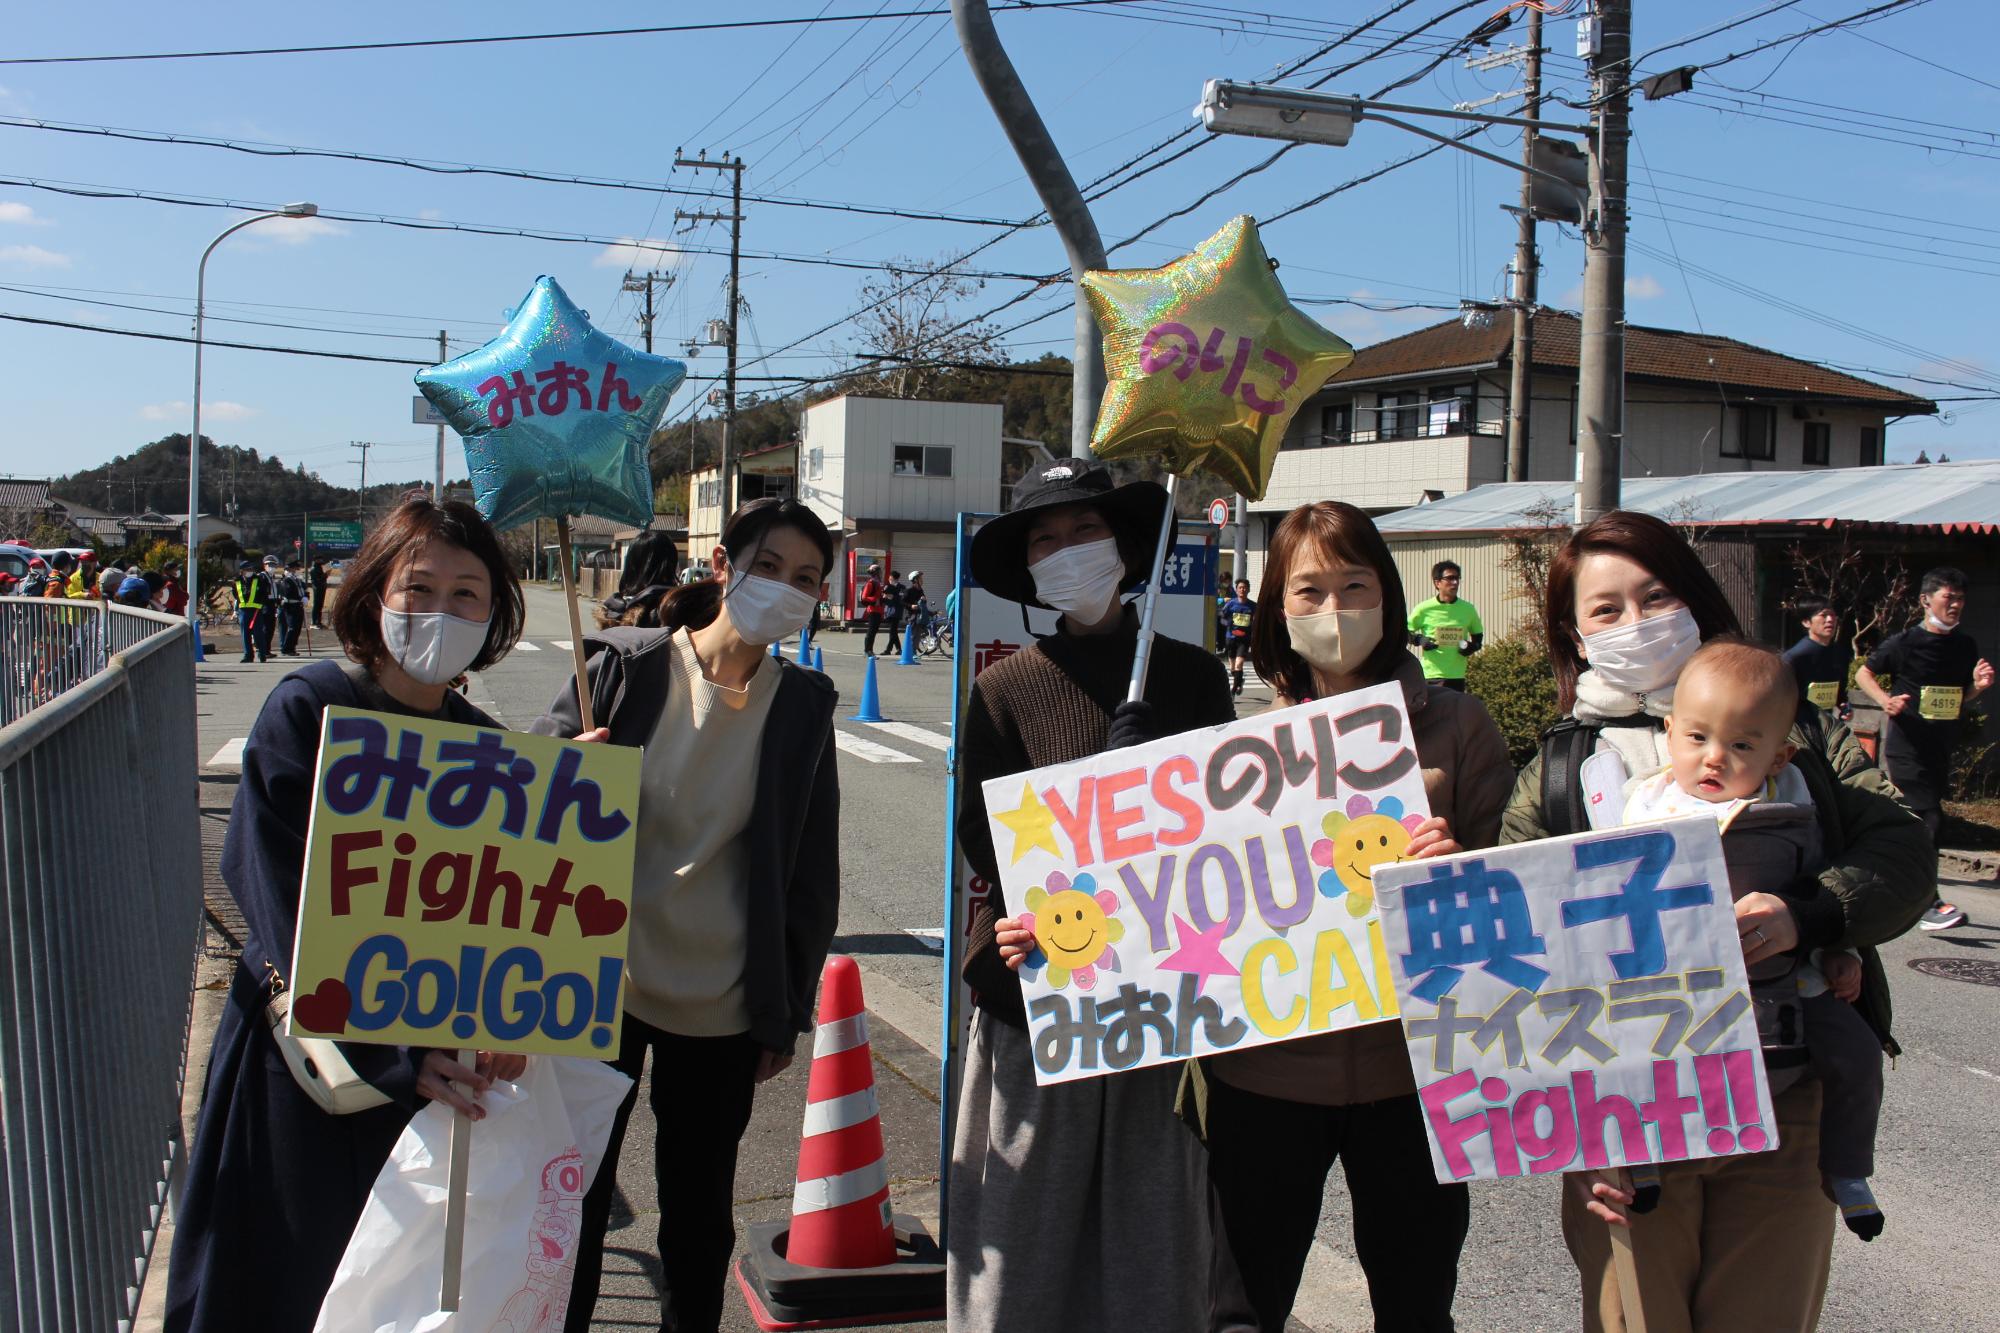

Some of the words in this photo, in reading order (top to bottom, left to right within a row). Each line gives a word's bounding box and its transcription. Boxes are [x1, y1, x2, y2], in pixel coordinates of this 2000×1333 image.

[477, 361, 642, 429] みおん
[1139, 322, 1298, 416] のりこ
[1440, 633, 1458, 641] 4002
[1930, 698, 1956, 709] 4819
[323, 717, 632, 845] みおん
[1041, 755, 1206, 867] YES
[1204, 703, 1419, 816] のりこ
[331, 829, 576, 937] Fight
[1117, 824, 1315, 953] YOU
[1400, 830, 1714, 1005] 典子
[1030, 973, 1249, 1075] みおん
[1405, 968, 1752, 1073] ナイスラン
[1418, 1049, 1769, 1180] Fight!!
